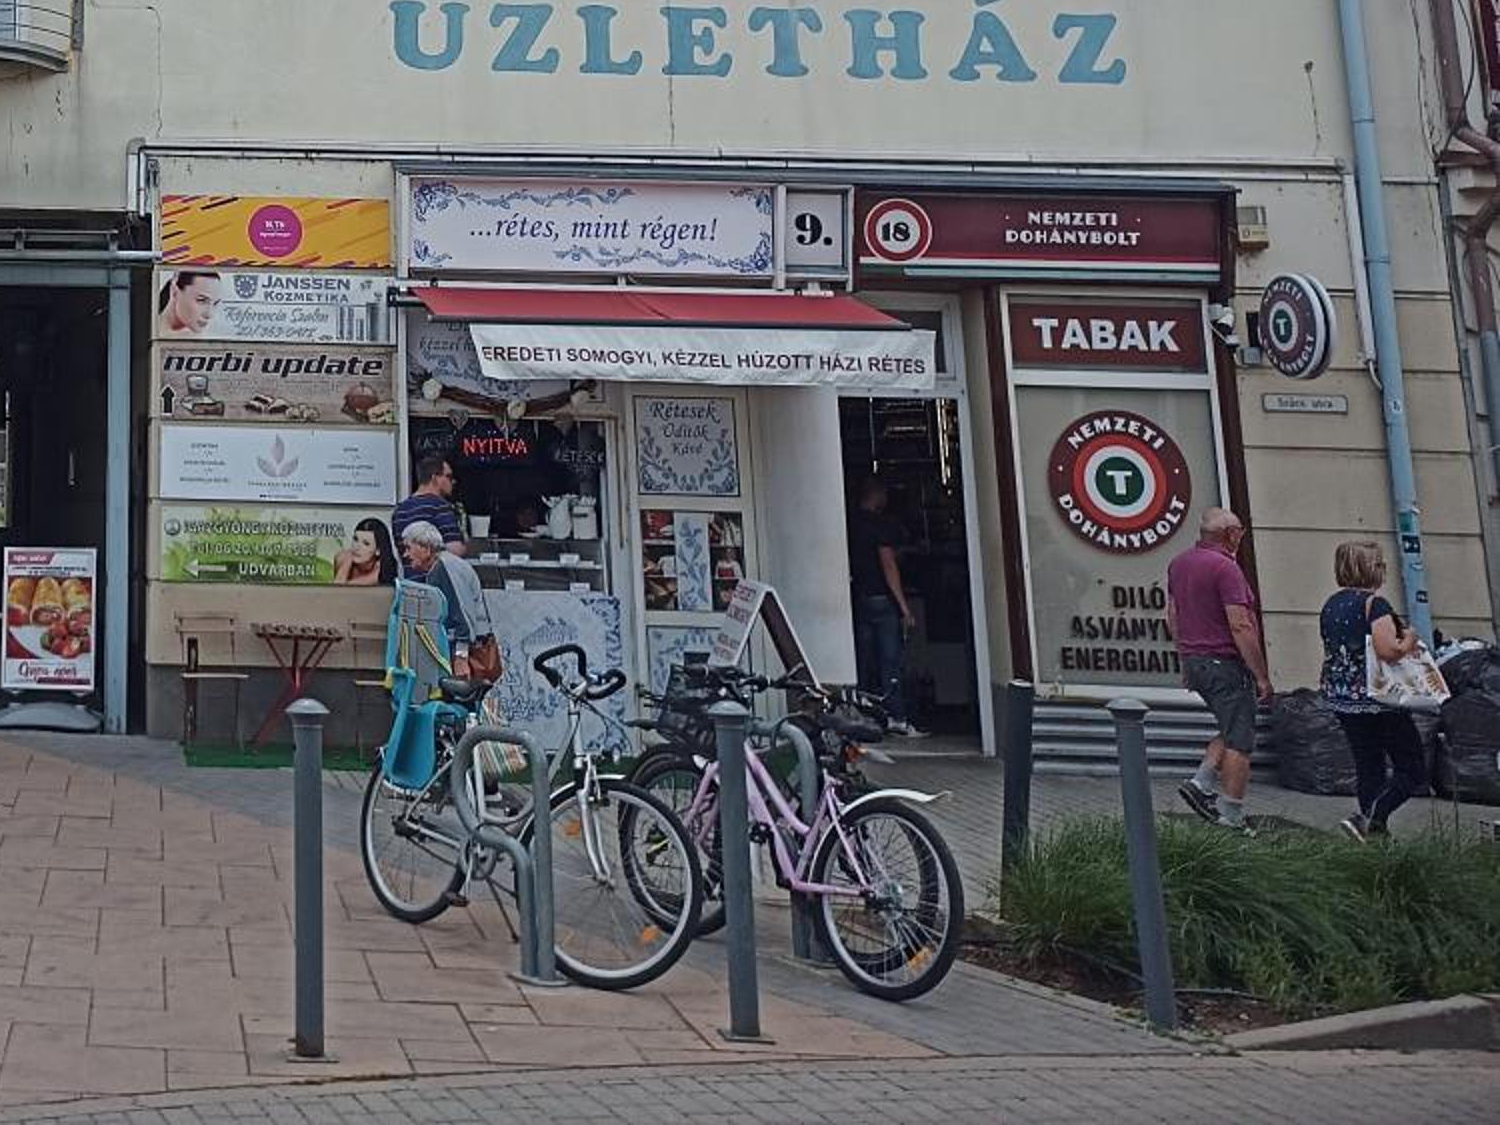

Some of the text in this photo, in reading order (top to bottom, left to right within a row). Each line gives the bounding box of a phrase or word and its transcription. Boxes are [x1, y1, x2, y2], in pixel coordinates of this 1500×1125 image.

[794, 213, 834, 246] 9.
[1027, 211, 1118, 226] NEMZETI
[571, 213, 630, 240] mint
[639, 217, 718, 249] régen!
[881, 221, 911, 242] 18
[1005, 228, 1141, 246] DOHÁNYBOLT
[261, 274, 351, 292] JANSSEN
[1032, 317, 1182, 353] TABAK
[1276, 318, 1288, 336] T
[163, 352, 383, 378] norbi update
[482, 346, 925, 374] EREDETI SOMOGYI, KÉZZEL HÚZOTT HÁZI RÉTES
[649, 401, 721, 424] Rétesek
[1066, 415, 1166, 451] NEMZETI
[461, 437, 529, 456] NYITVA
[1105, 469, 1133, 496] T
[1058, 493, 1187, 549] DOHÁNYBOLT
[238, 562, 315, 577] UDVARBAN
